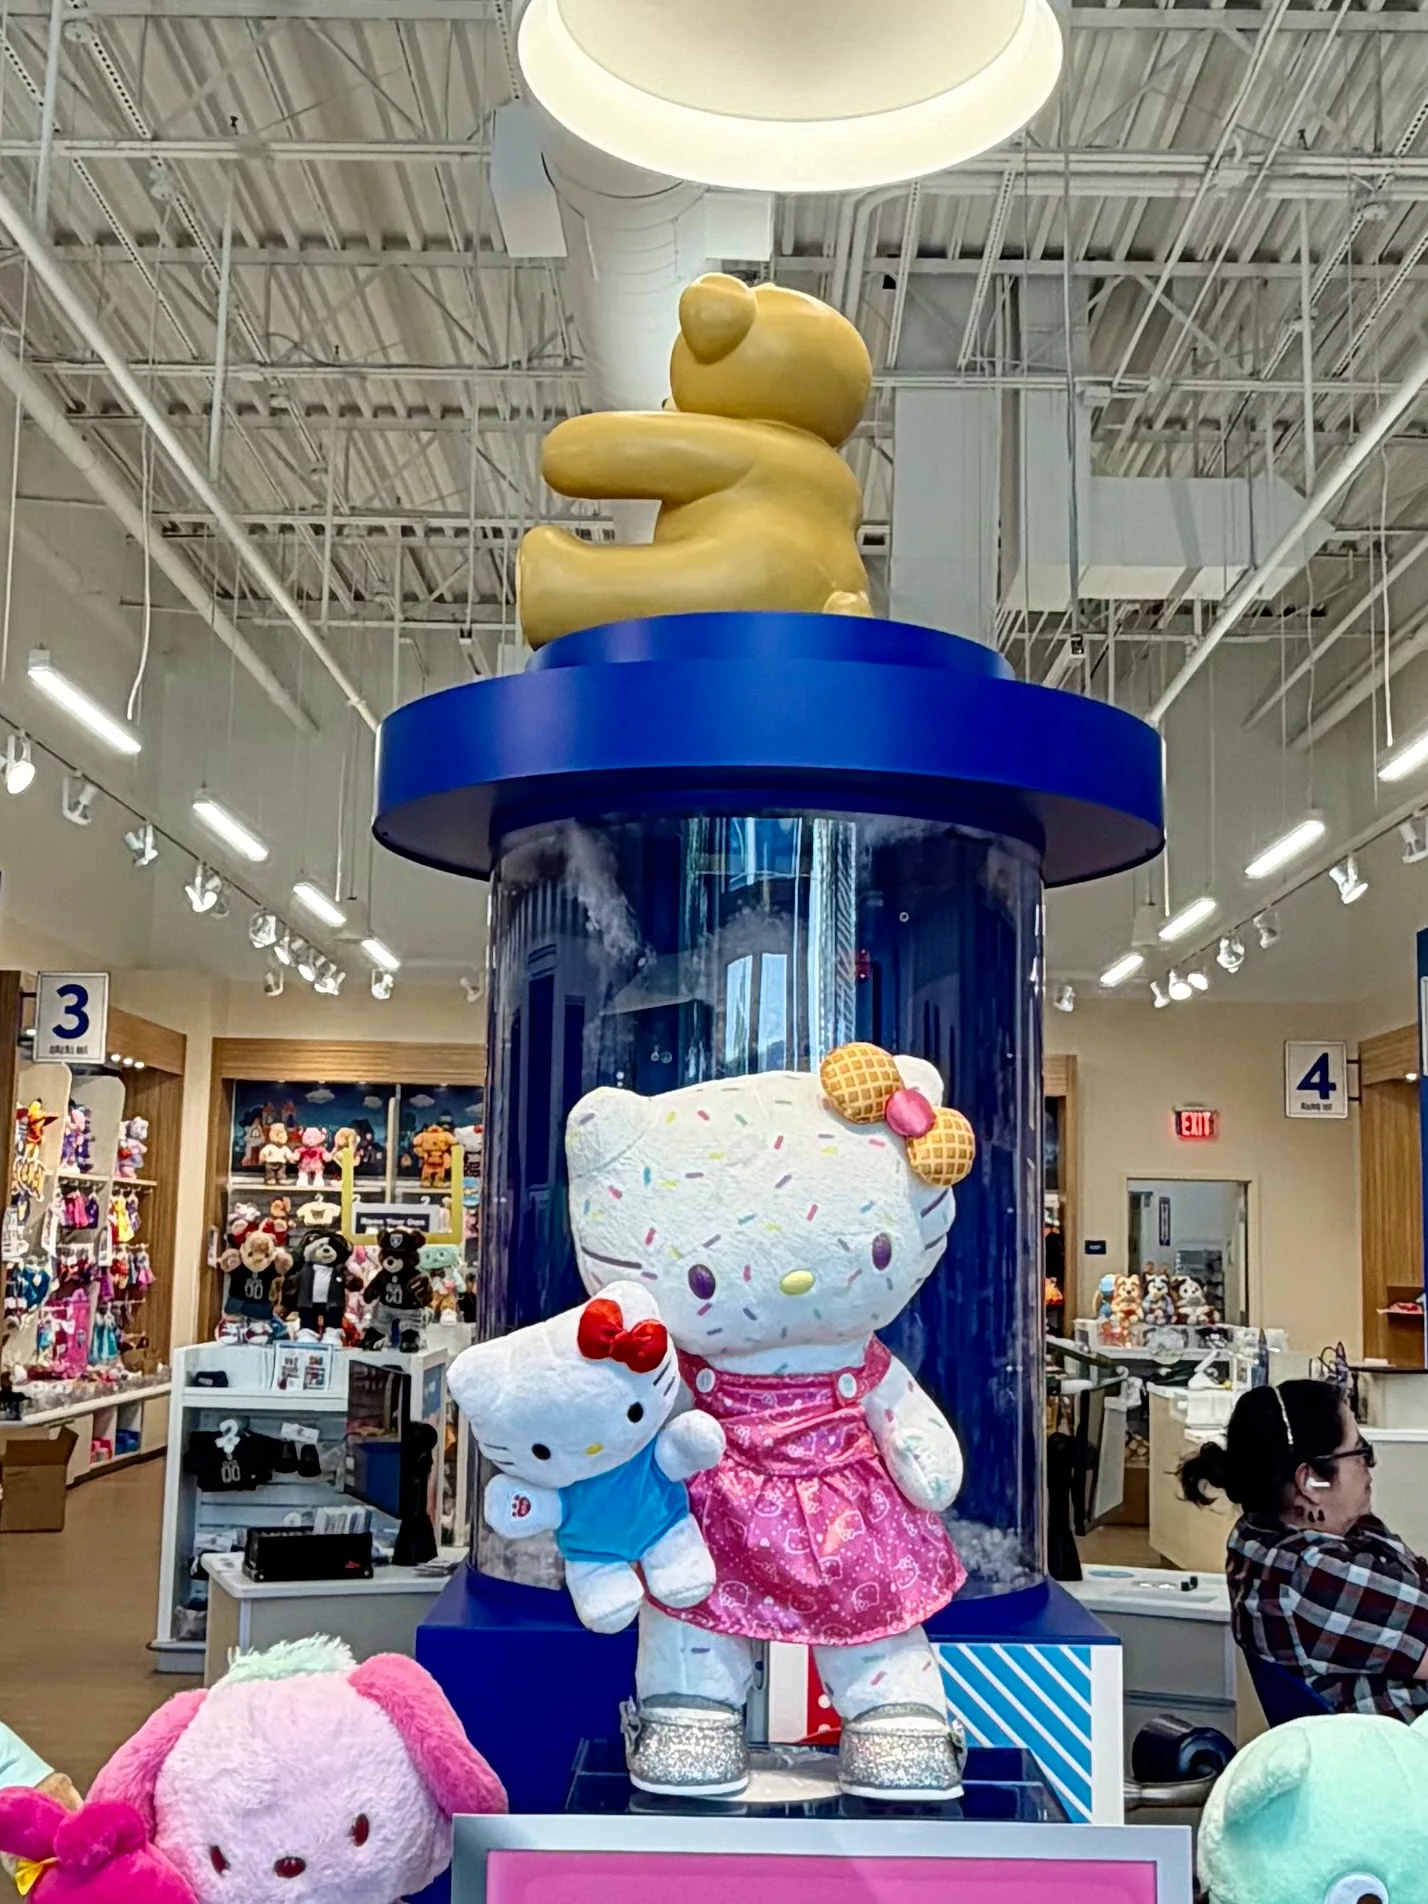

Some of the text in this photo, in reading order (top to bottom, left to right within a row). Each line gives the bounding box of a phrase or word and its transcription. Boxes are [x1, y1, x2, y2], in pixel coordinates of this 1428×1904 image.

[52, 983, 89, 1039] 3
[1297, 1052, 1336, 1099] 4
[1181, 1111, 1211, 1136] EXIT
